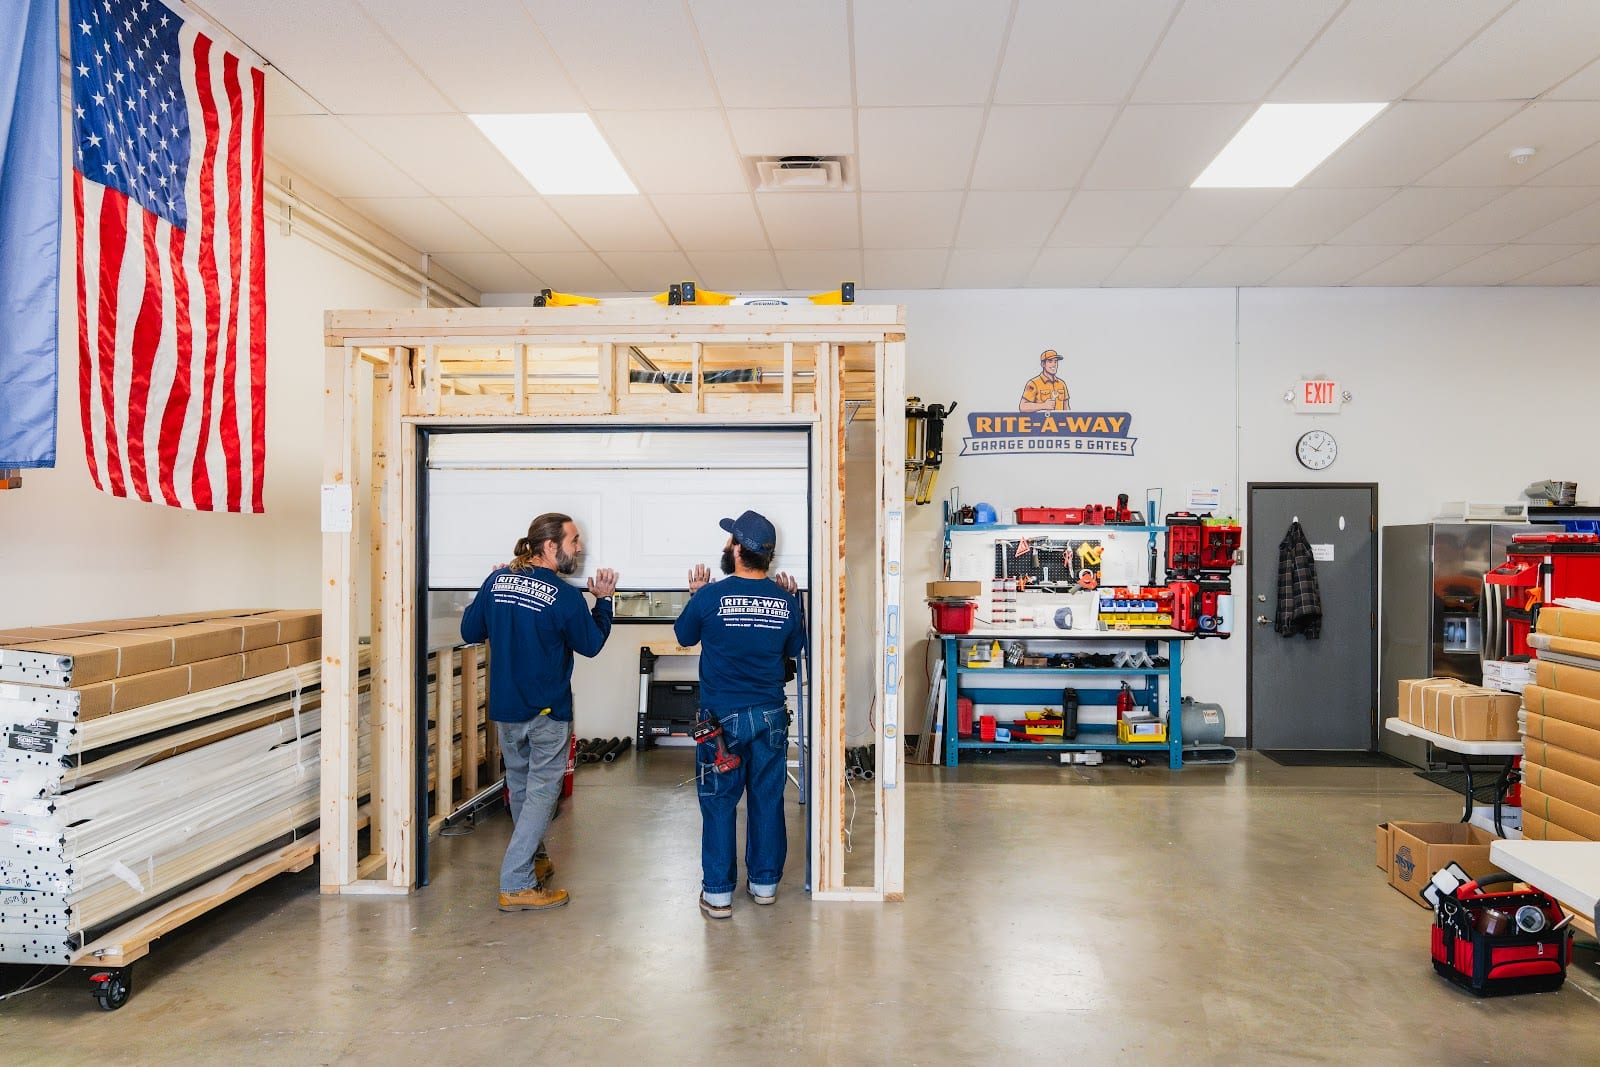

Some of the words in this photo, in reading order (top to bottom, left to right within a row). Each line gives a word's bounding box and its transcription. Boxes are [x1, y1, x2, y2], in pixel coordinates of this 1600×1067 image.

[1305, 382, 1335, 404] EXIT
[976, 416, 1125, 433] RITE-A-WAY
[972, 440, 1024, 451] GARAGE
[1028, 440, 1070, 449] DOORS
[1075, 440, 1083, 449] &
[1087, 441, 1127, 451] GATES
[498, 576, 554, 594] RITE-A-WAY
[724, 598, 785, 608] RITE-A-WAY
